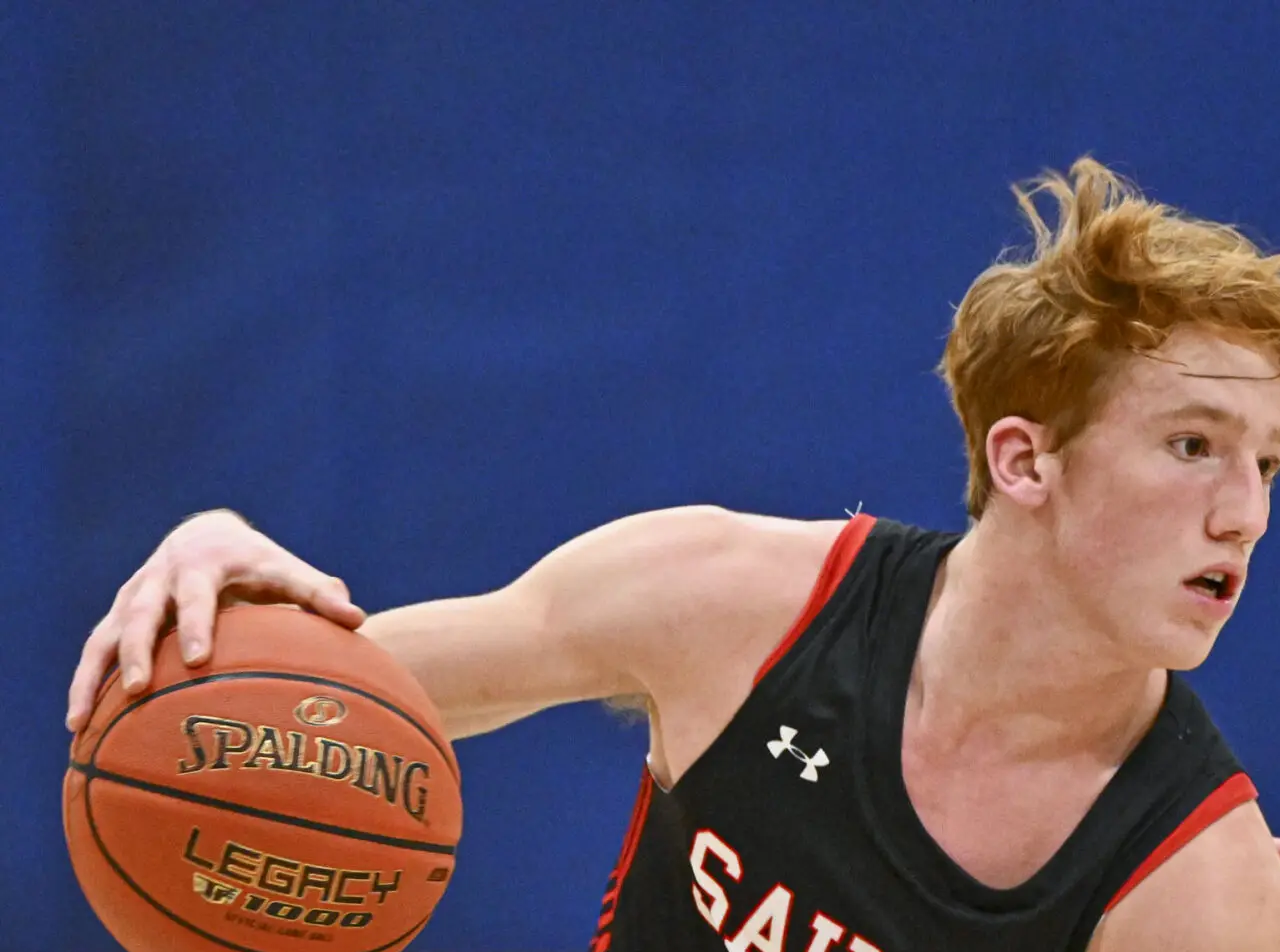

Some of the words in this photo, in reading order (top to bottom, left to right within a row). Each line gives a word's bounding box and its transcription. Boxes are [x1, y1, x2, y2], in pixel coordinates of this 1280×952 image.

[177, 714, 430, 824] SPALDING
[181, 826, 403, 905] LEGACY
[241, 893, 374, 929] 1000
